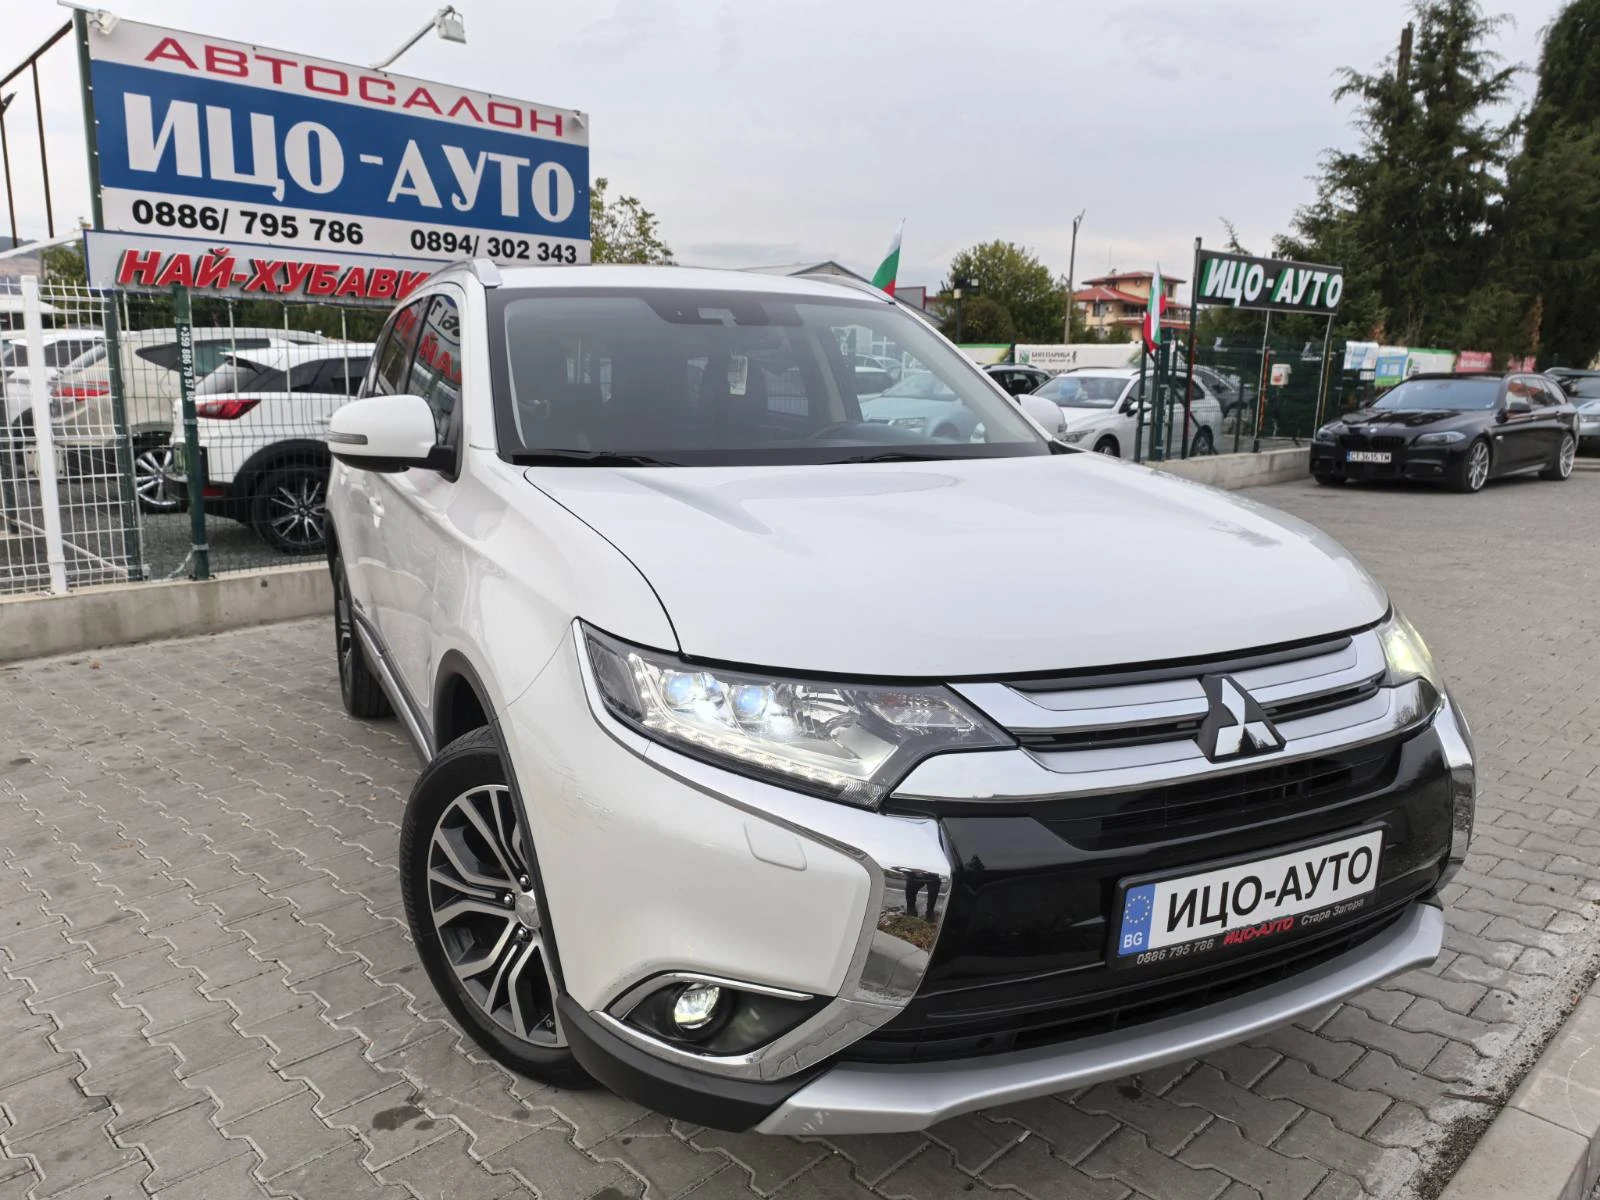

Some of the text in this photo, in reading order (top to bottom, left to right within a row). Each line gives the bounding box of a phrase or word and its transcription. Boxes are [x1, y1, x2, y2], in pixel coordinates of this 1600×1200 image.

[144, 36, 563, 137] АВТОСАЛОН
[131, 199, 577, 264] 0886/ 795 786 0894/ 302 343
[1202, 257, 1344, 308] ИЦО-АУТО
[1165, 845, 1373, 933] ИЦО-АУТО
[1123, 931, 1143, 948] BG
[1136, 938, 1214, 965] 0886 795 786
[1223, 917, 1295, 945] ИЦО-АУТО
